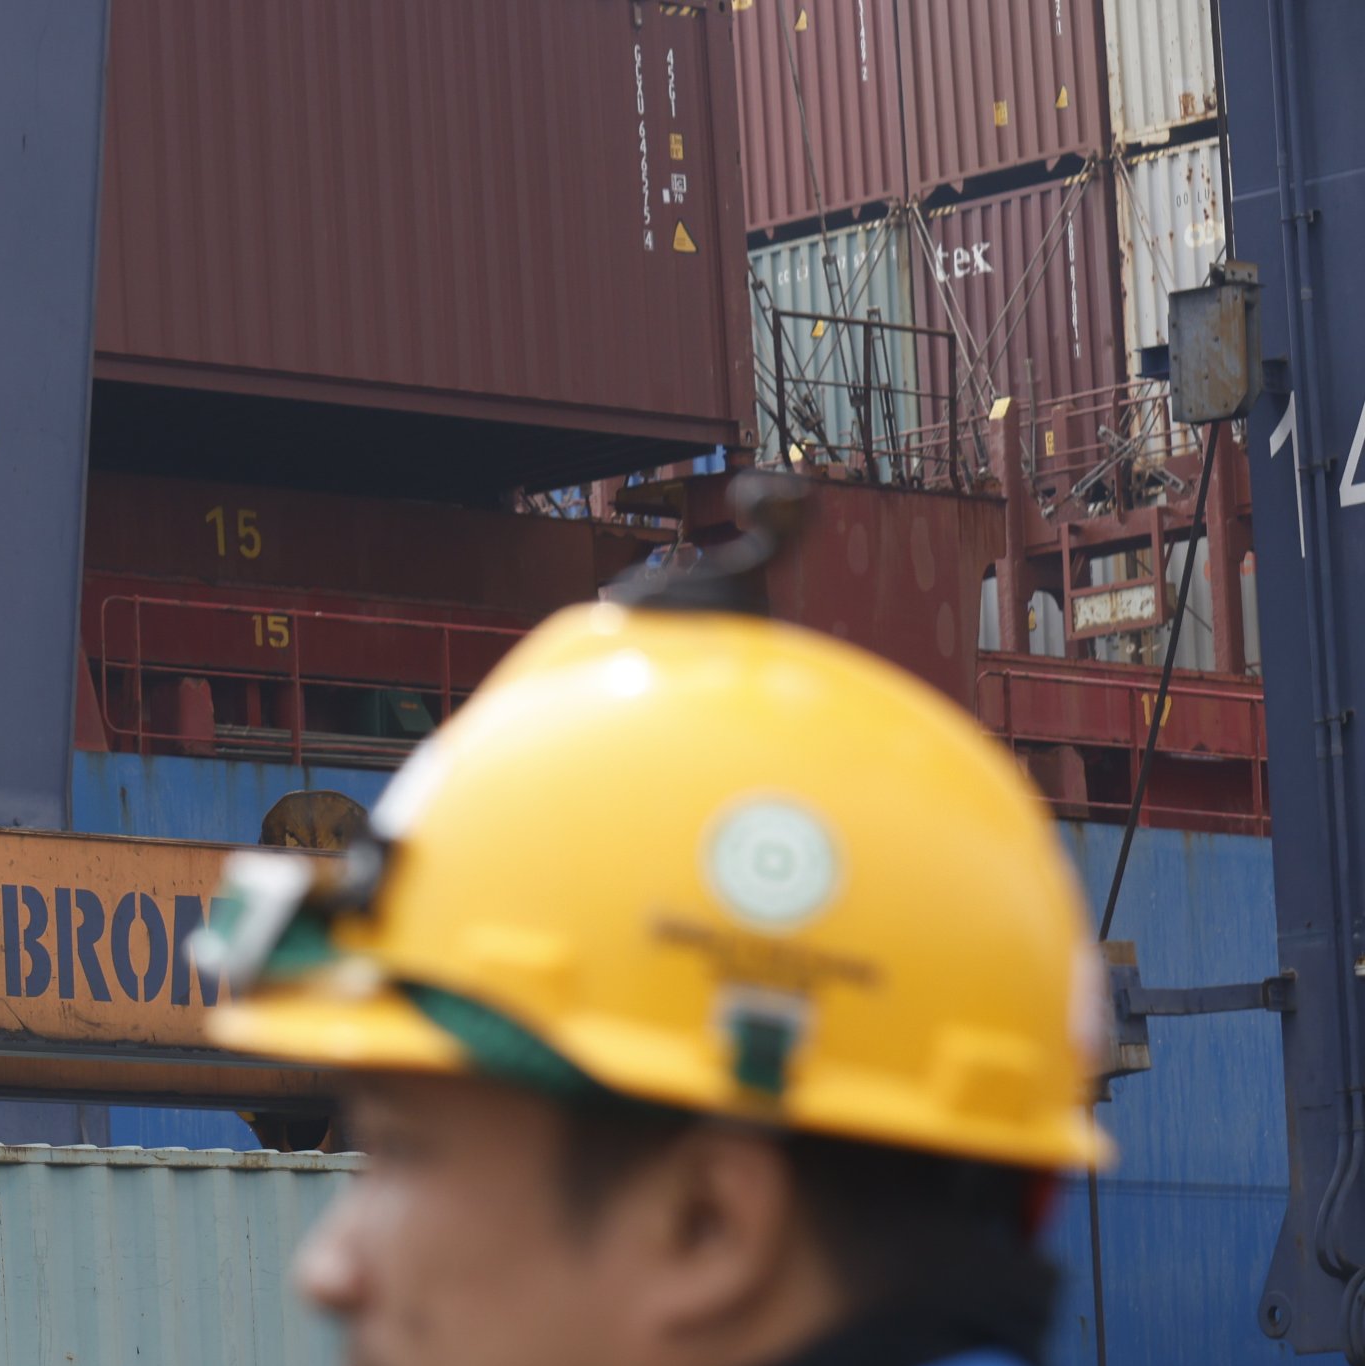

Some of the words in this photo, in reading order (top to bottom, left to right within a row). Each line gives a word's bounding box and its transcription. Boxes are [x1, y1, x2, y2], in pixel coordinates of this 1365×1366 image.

[205, 505, 262, 559] 15
[251, 613, 290, 649] 15
[1, 884, 235, 1007] BROM
